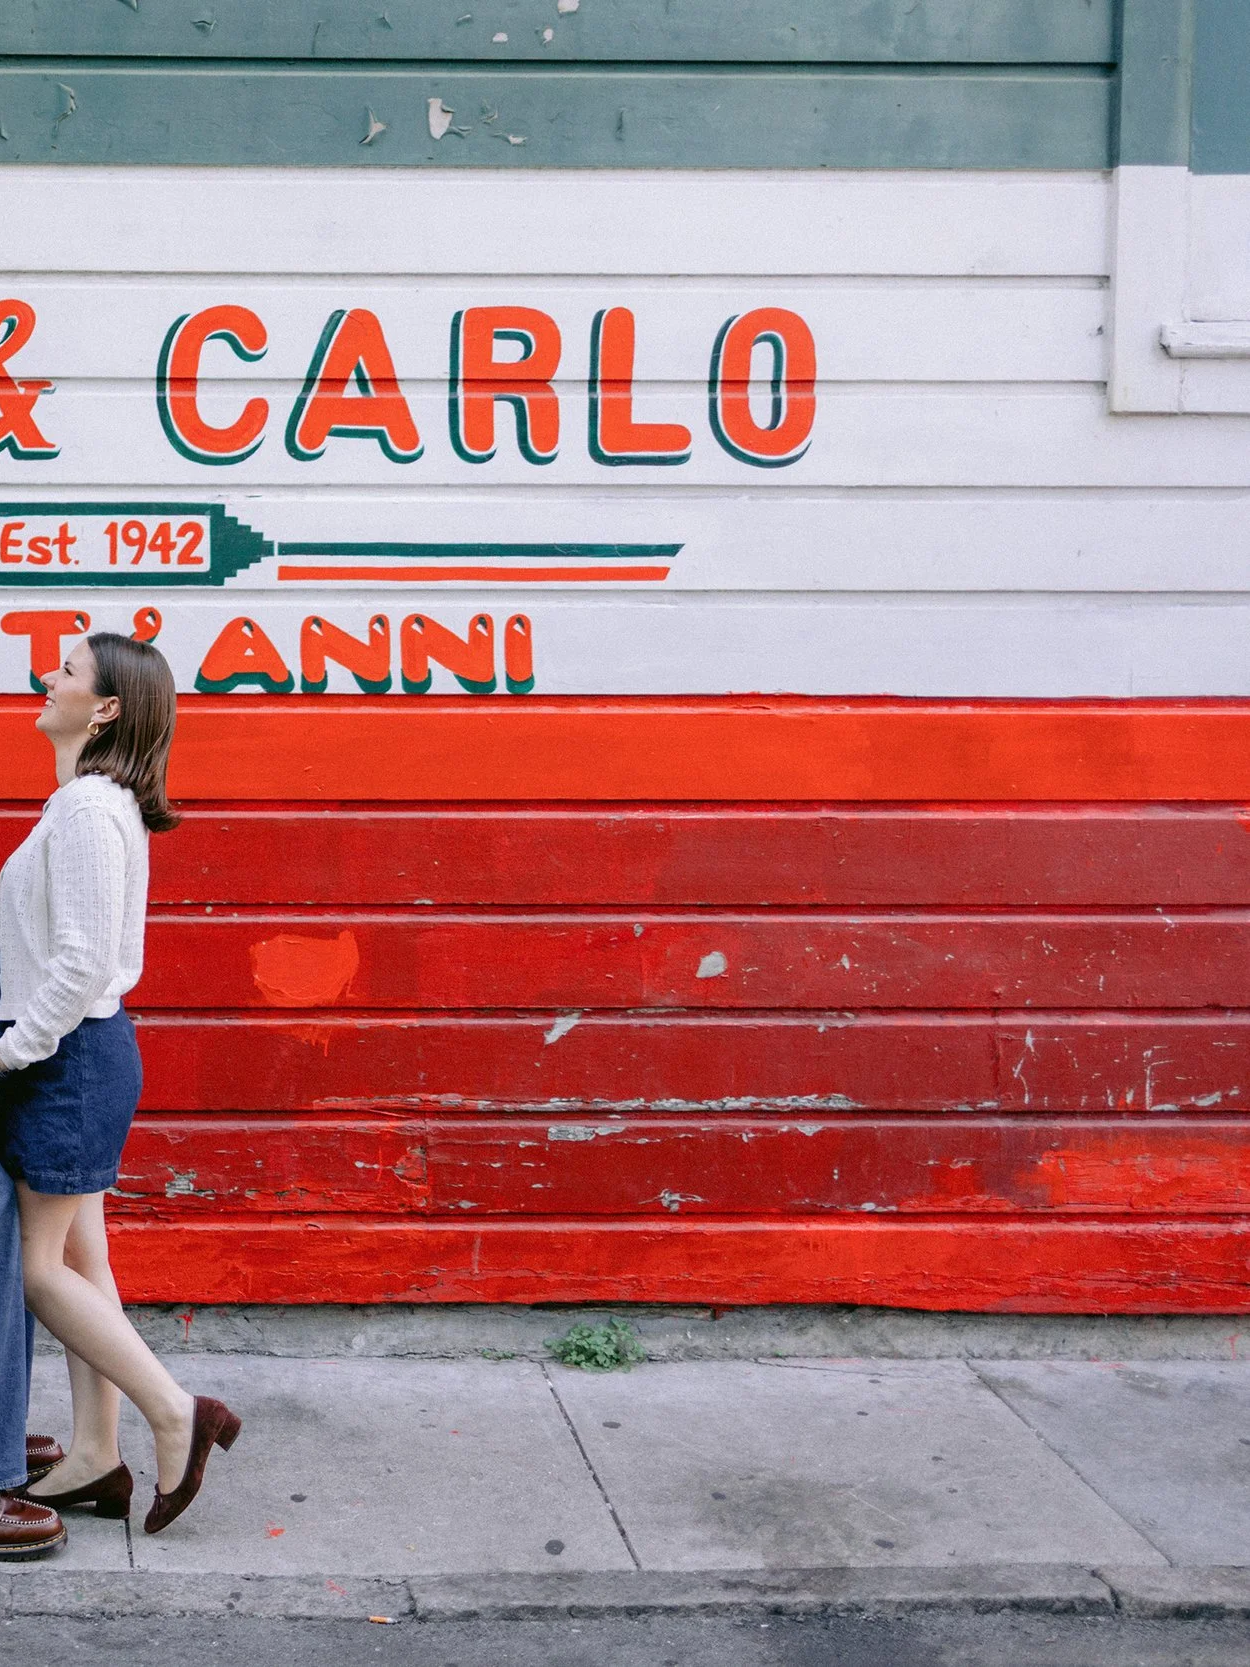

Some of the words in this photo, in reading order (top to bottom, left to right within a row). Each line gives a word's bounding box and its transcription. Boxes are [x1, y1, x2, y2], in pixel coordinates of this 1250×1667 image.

[156, 304, 817, 468] CARLO
[0, 520, 80, 566] Est.
[103, 519, 205, 566] 1942
